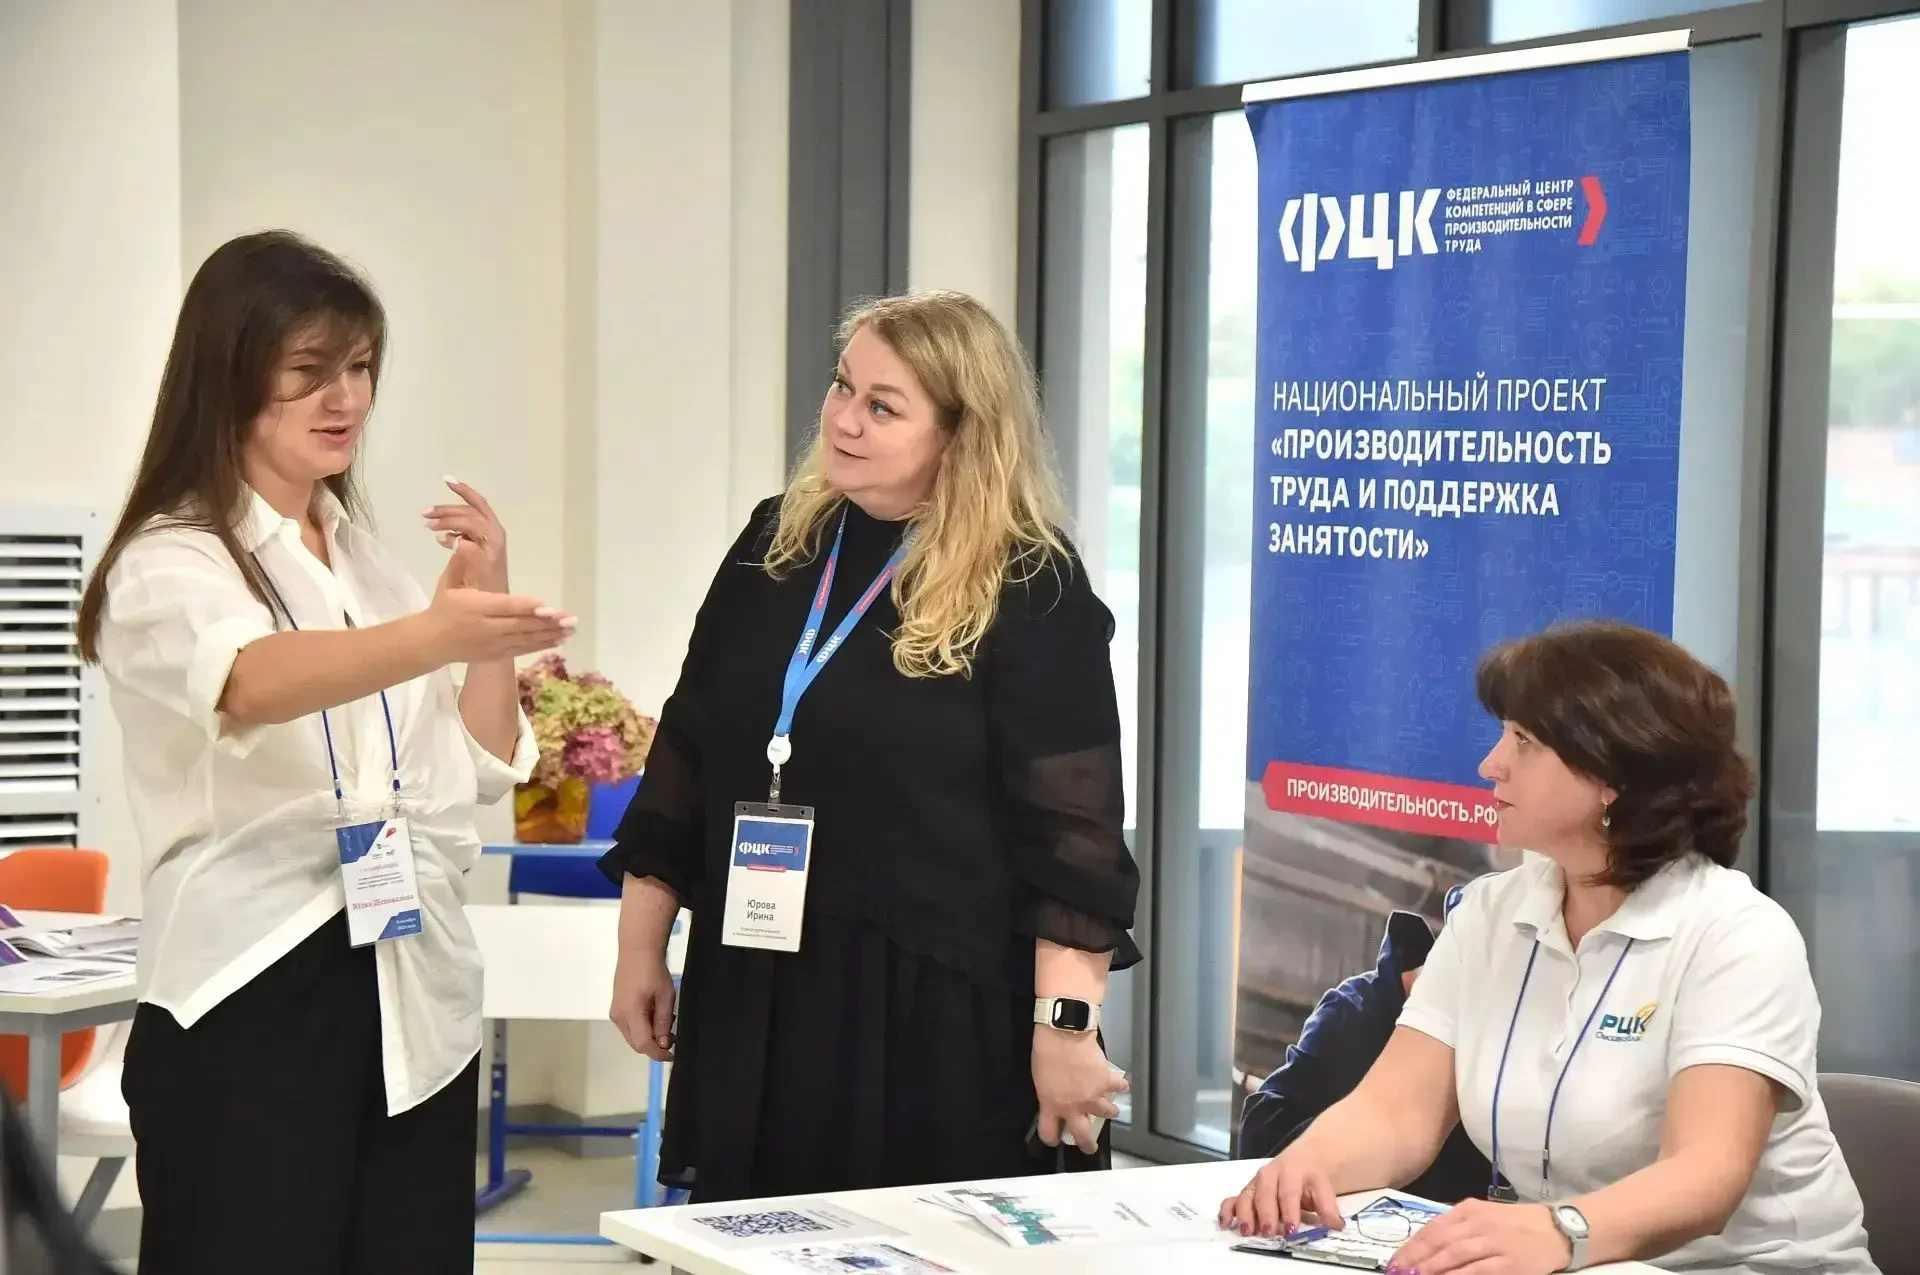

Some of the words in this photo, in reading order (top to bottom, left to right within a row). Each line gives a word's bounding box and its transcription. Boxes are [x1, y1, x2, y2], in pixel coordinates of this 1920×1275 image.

[1446, 180, 1531, 202] ФЕДЕРАЛЬНЫЙ
[1535, 179, 1574, 197] ЦЕНТР
[1445, 198, 1524, 218] КОМПЕТЕНЦИЙ
[1526, 201, 1534, 213] В
[1536, 197, 1573, 213] СФЕРЕ
[1278, 188, 1442, 272] ФЦК
[1445, 215, 1572, 236] ПРОИЗВОДИТЕЛЬНОСТИ
[1445, 238, 1482, 254] ТРУДА
[1273, 371, 1488, 416] НАЦИОНАЛЬНЫЙ
[1496, 378, 1607, 413] ПРОЕКТ
[1271, 428, 1612, 467] «ПРОИЗВОДИТЕЛЬНОСТЬ
[1270, 475, 1350, 513] ТРУДА
[1358, 478, 1376, 509] И
[1384, 479, 1560, 518] ПОДДЕРЖКА
[1269, 522, 1429, 560] ЗАНЯТОСТИ»
[1287, 777, 1498, 827] ПРОИЗВОДИТЕЛЬНОСТЬ.РФ
[738, 841, 771, 856] ФЦК
[746, 910, 774, 922] Ирина
[747, 898, 776, 911] Юрова
